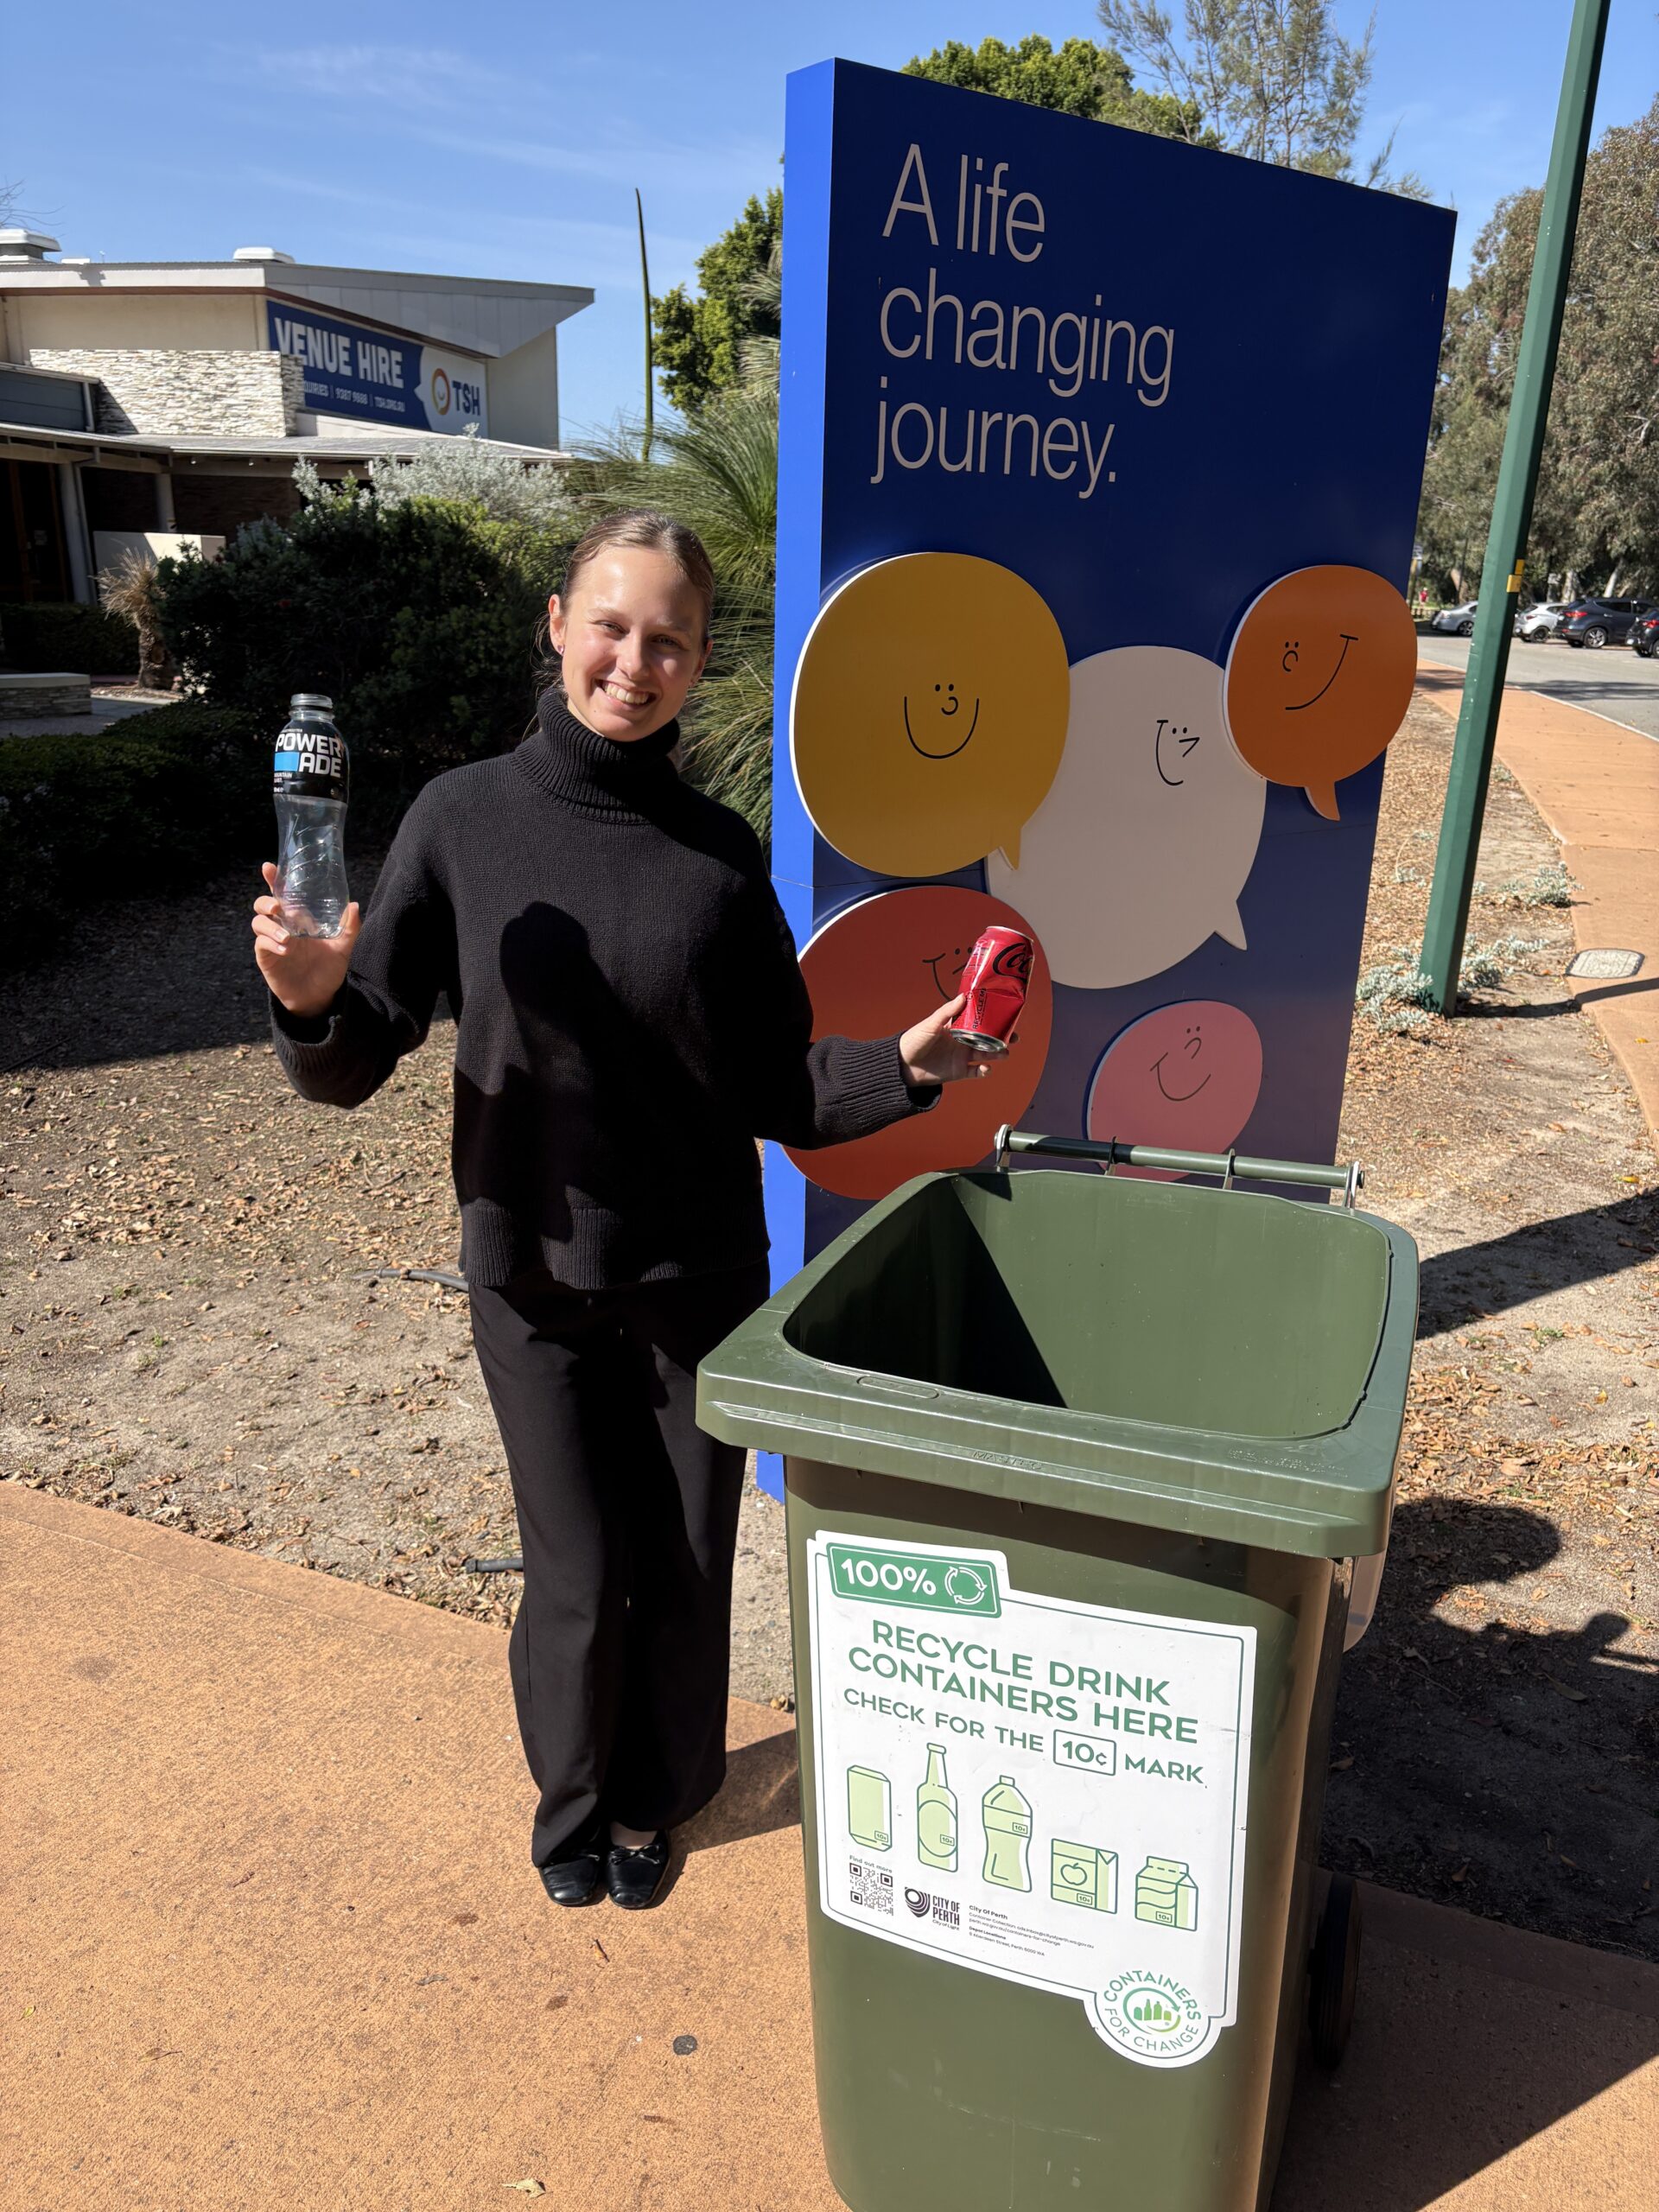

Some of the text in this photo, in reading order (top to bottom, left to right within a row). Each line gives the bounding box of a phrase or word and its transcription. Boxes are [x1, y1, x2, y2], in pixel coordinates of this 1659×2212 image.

[881, 143, 1046, 263] A life
[274, 317, 404, 389] VENUE HIRE
[880, 267, 1175, 407] changing
[452, 380, 481, 416] TSH
[871, 376, 1116, 499] journey.
[275, 733, 341, 758] POWER
[299, 752, 342, 779] ADE
[841, 1557, 937, 1596] 100%
[873, 1619, 1172, 1707] RECYCLE DRINK
[849, 1647, 1199, 1744] CONTAINERS HERE
[844, 1688, 926, 1725] CHECK
[935, 1712, 985, 1740] FOR
[995, 1726, 1045, 1753] THE
[1125, 1754, 1204, 1784] MARK
[849, 1855, 863, 1864] Find
[876, 1865, 893, 1873] more
[932, 1896, 960, 1912] CITY OF
[932, 1907, 960, 1926] PERTH
[969, 1905, 982, 1914] City
[991, 1910, 1008, 1920] Perth
[1103, 1970, 1202, 2020] CONTAINERS
[1104, 2007, 1199, 2052] FOR CHANGE
